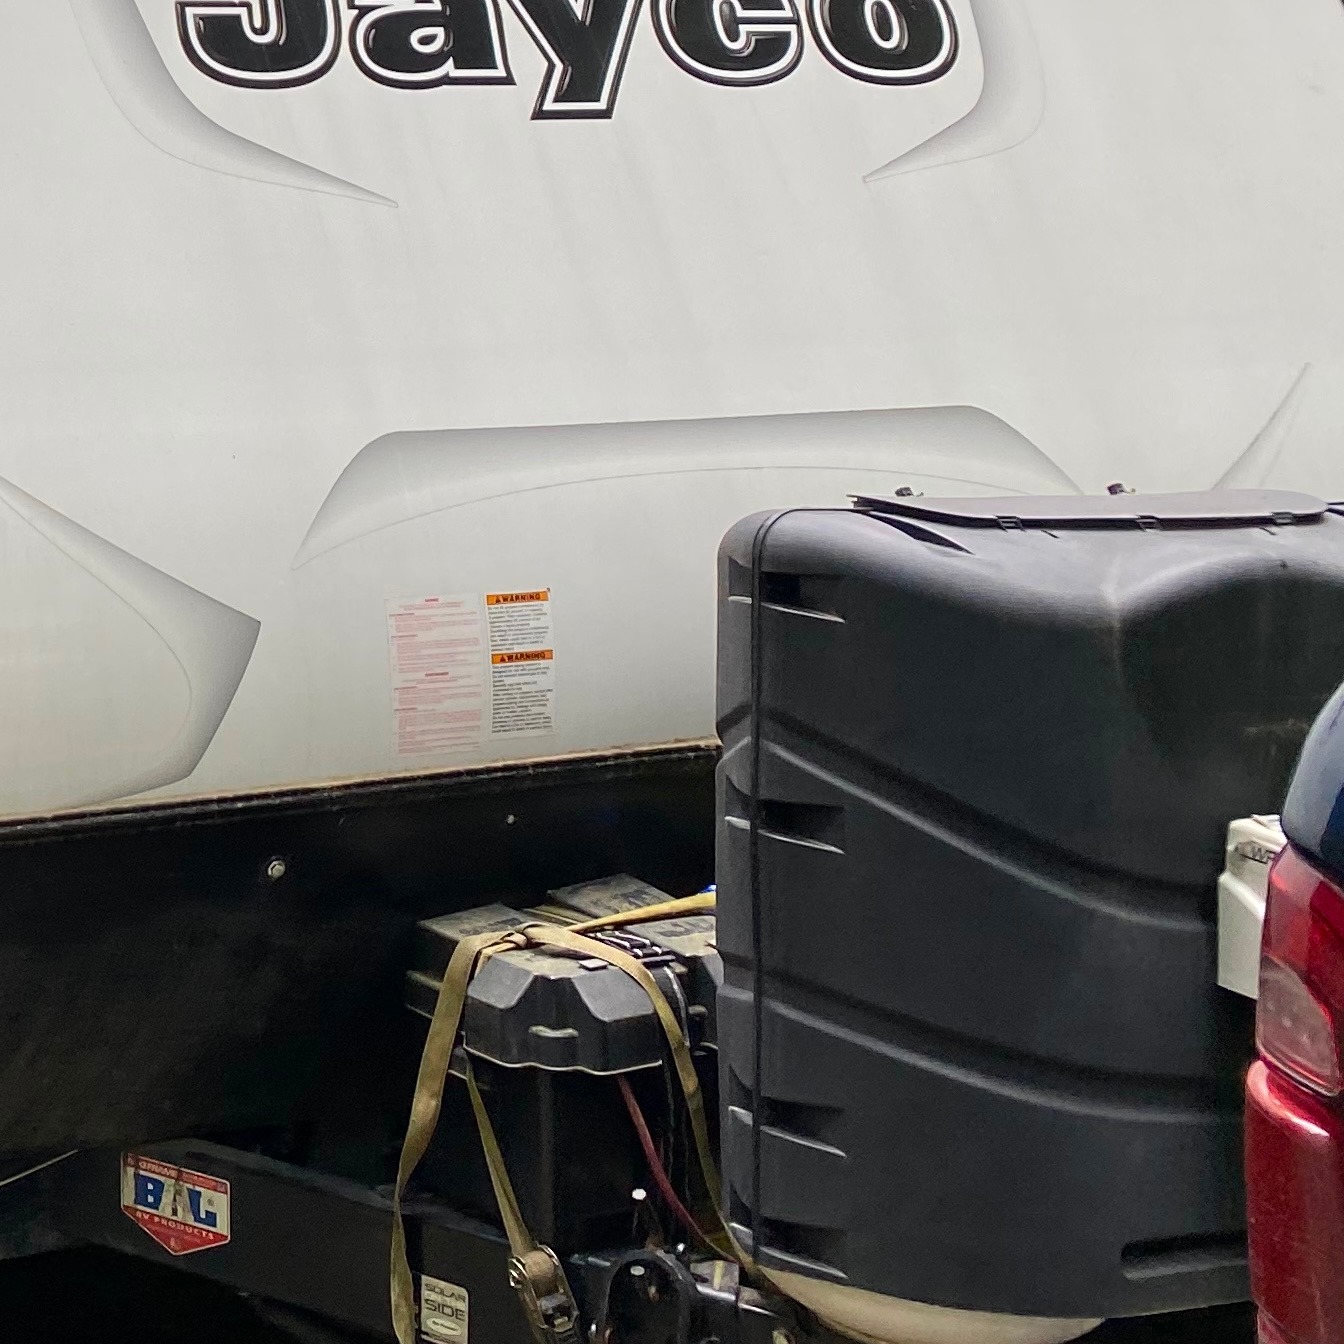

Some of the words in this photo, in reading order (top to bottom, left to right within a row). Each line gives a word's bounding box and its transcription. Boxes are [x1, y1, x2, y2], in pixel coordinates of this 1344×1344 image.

[502, 593, 541, 603] WARNING
[506, 651, 546, 662] WARNING
[154, 1216, 214, 1240] PRODUCTS
[424, 1283, 466, 1303] SOLAR
[424, 1299, 465, 1322] SIDE
